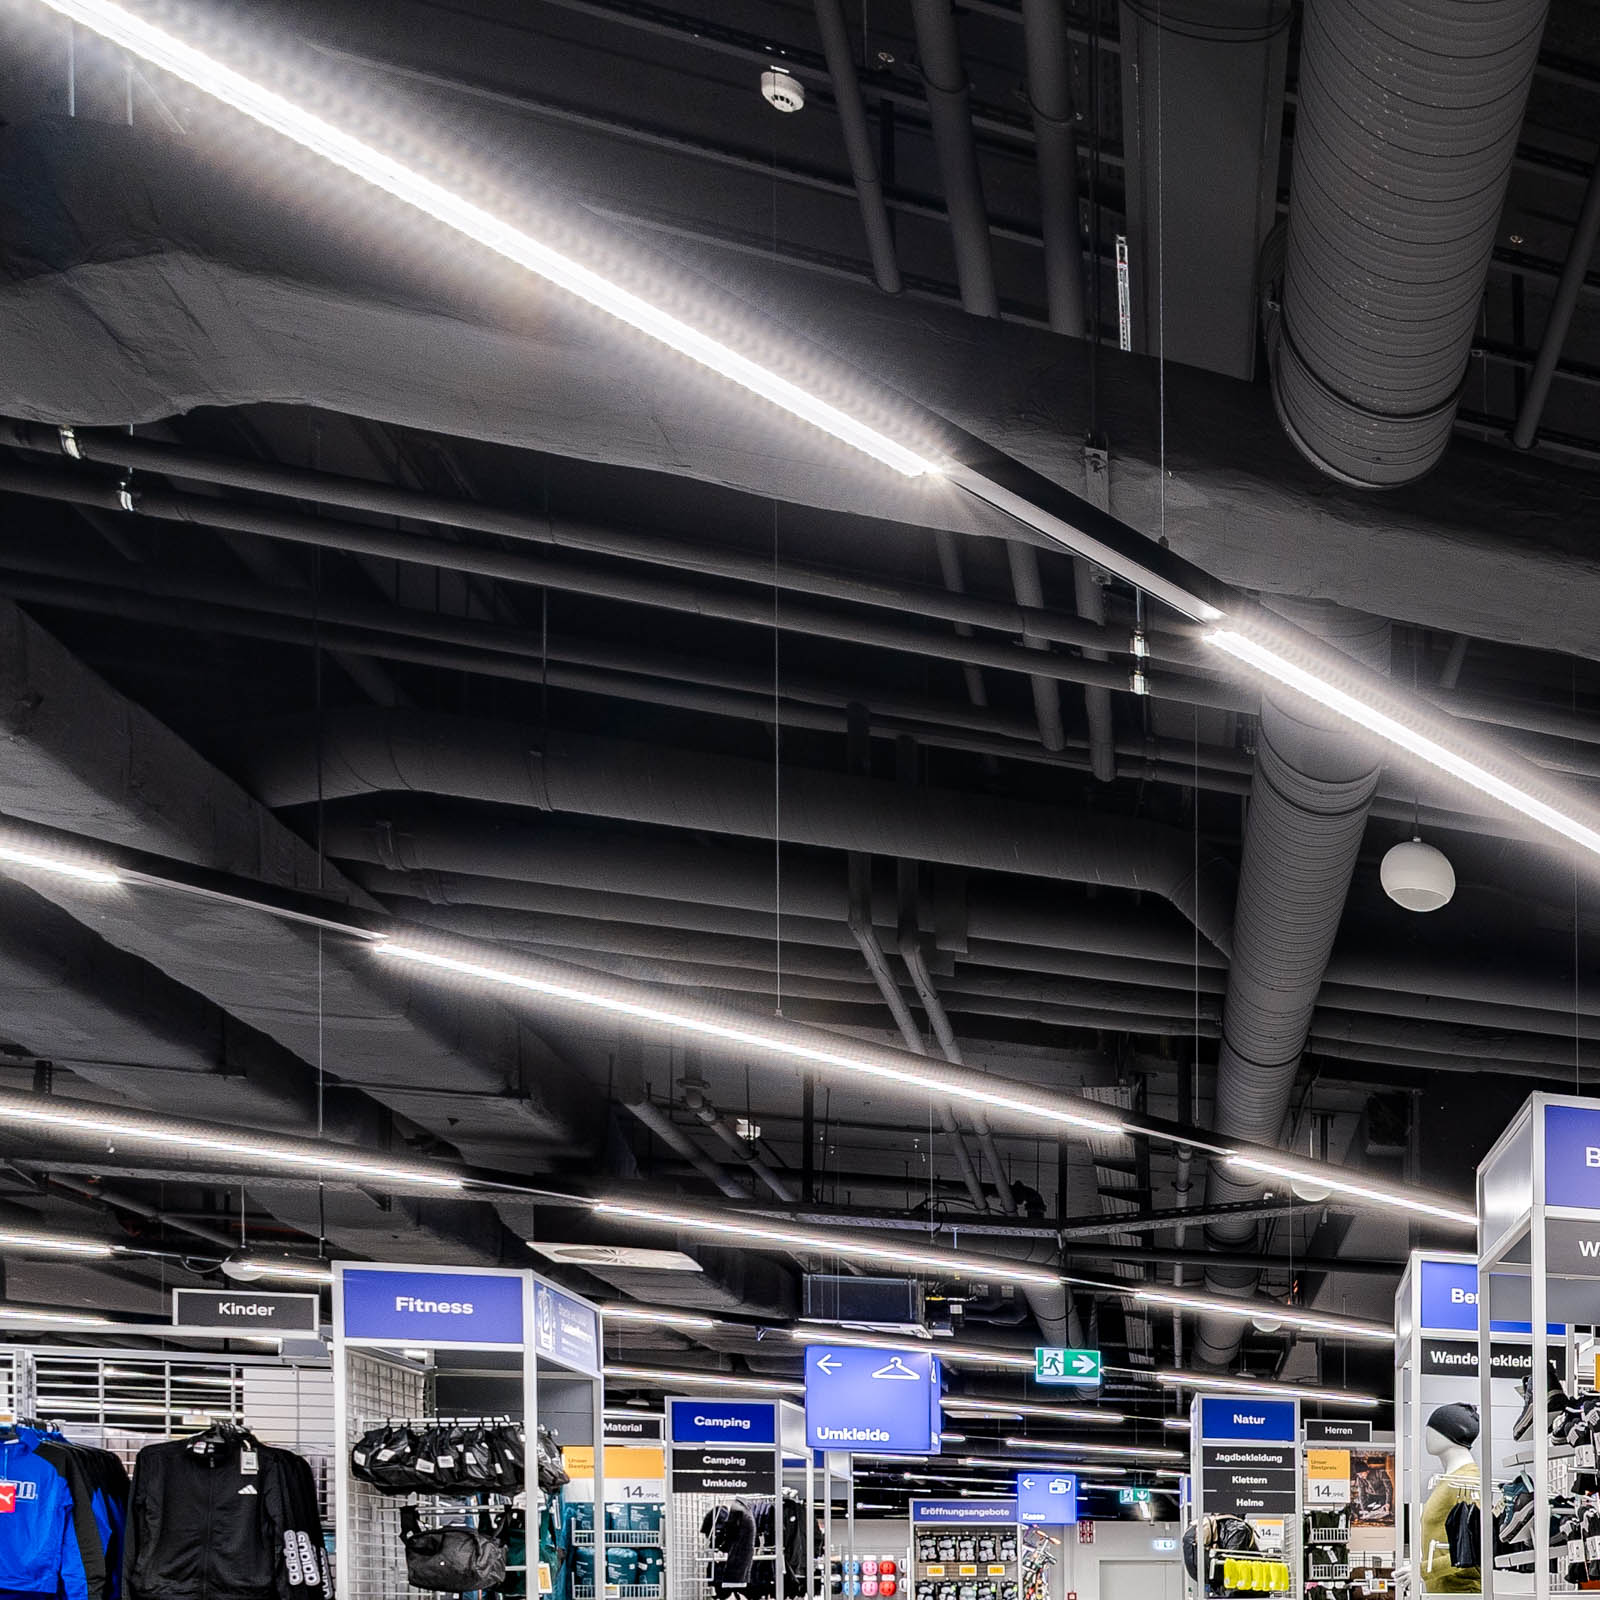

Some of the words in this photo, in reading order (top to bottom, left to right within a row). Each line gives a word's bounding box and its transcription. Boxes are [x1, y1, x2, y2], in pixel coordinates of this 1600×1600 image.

[218, 1302, 275, 1319] Kinder
[395, 1297, 474, 1316] Fitness
[694, 1415, 751, 1430] Camping
[1233, 1414, 1266, 1425] Natur
[603, 1422, 643, 1433] Material
[1324, 1426, 1353, 1435] Herren
[816, 1427, 890, 1442] Umkleide
[702, 1456, 746, 1467] Camping
[1215, 1453, 1283, 1464] Jagdbekleidung
[702, 1479, 747, 1489] Umkleide
[1232, 1475, 1268, 1485] Klettern
[1236, 1498, 1264, 1507] Helme
[920, 1506, 1010, 1517] Eröffnungsangebote
[1022, 1513, 1046, 1521] Kasse
[283, 1529, 303, 1586] adidas
